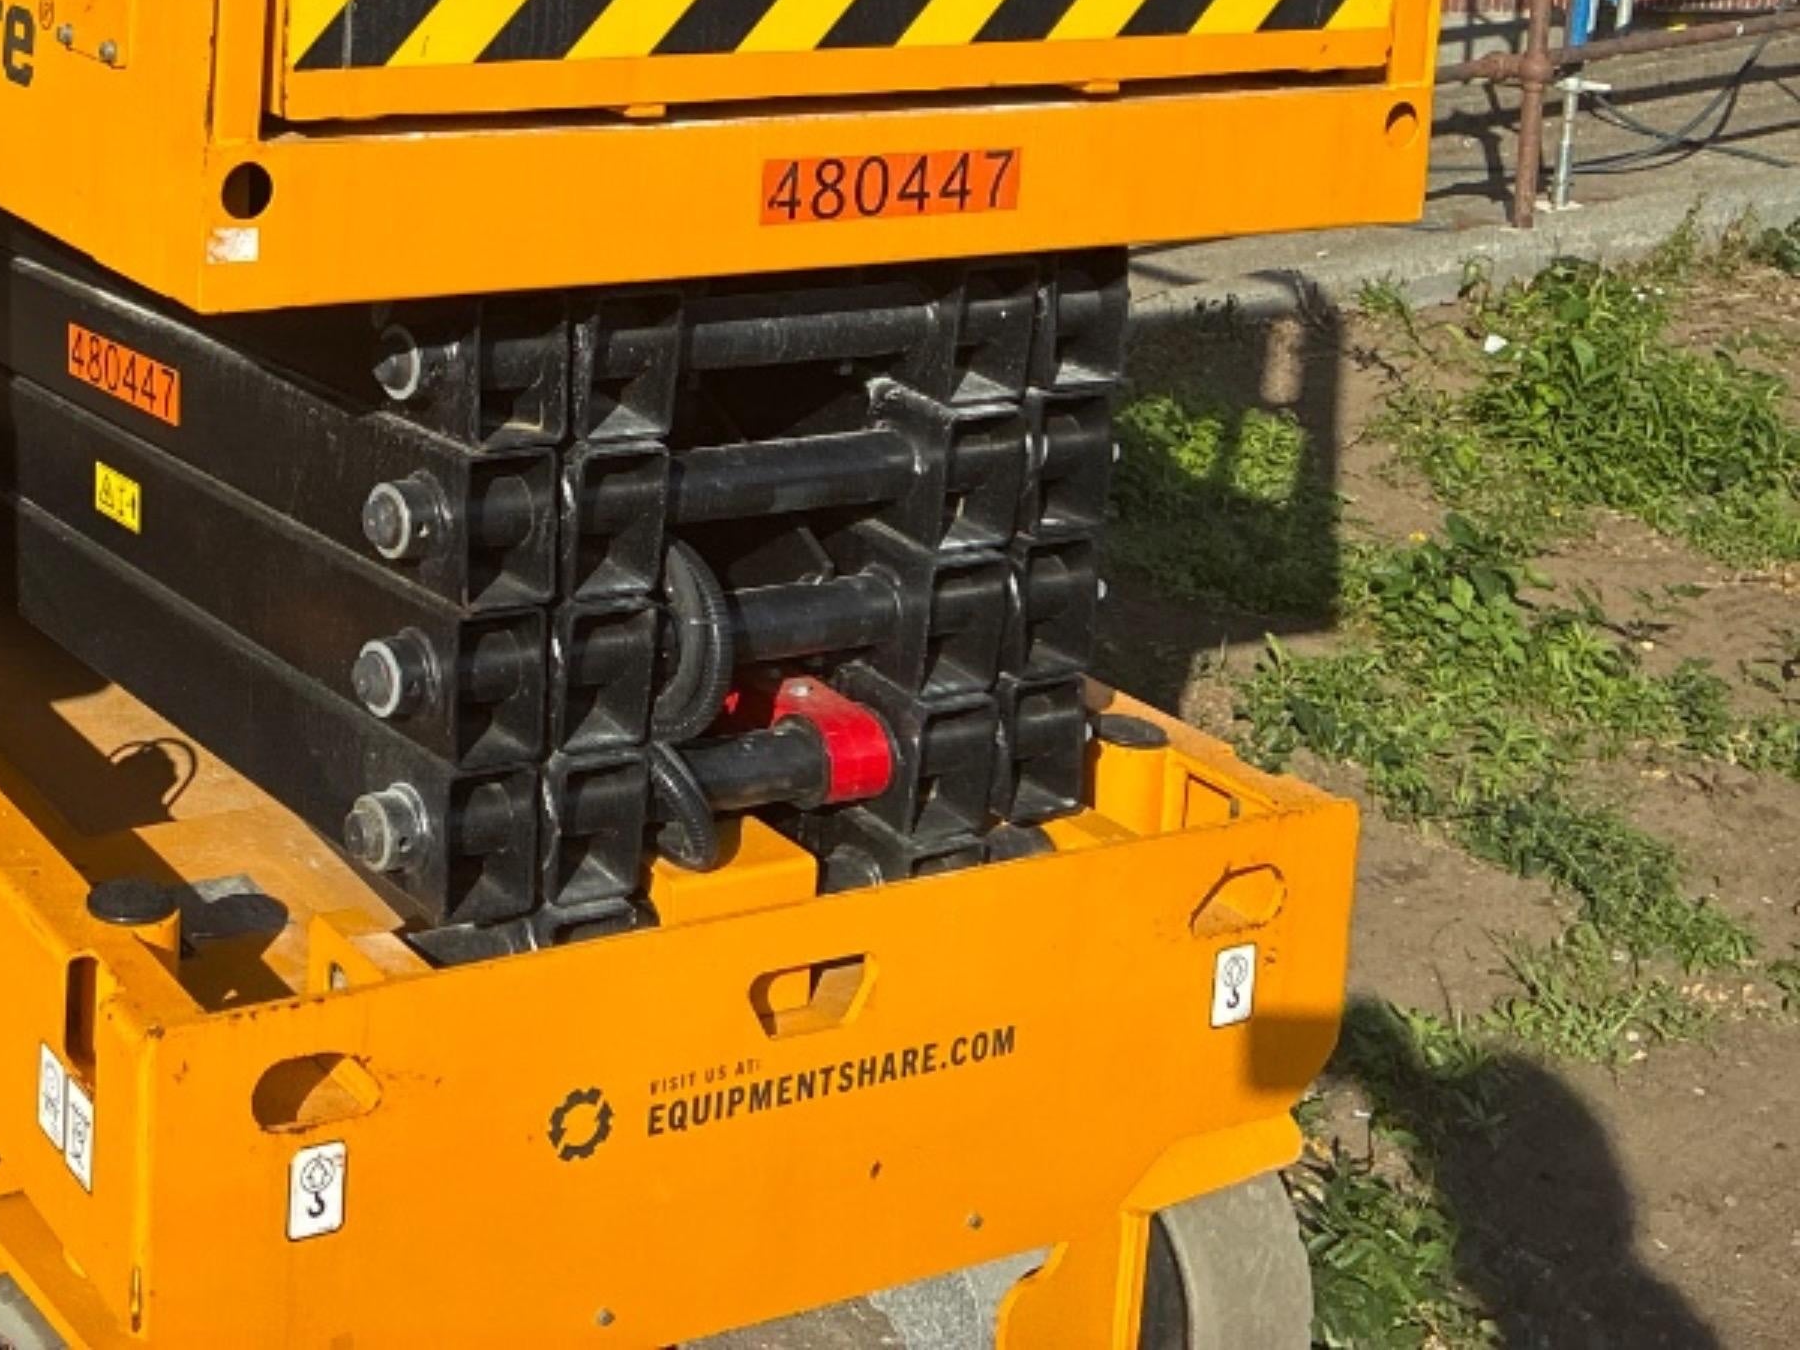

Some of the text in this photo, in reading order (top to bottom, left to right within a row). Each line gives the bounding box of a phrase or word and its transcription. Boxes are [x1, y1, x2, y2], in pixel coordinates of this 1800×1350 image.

[767, 149, 1015, 221] 480447
[70, 328, 176, 419] 480447
[646, 1024, 1017, 1138] EQUIPMENTSHARE.COM
[649, 1071, 697, 1096] VISIT
[704, 1064, 729, 1085] US
